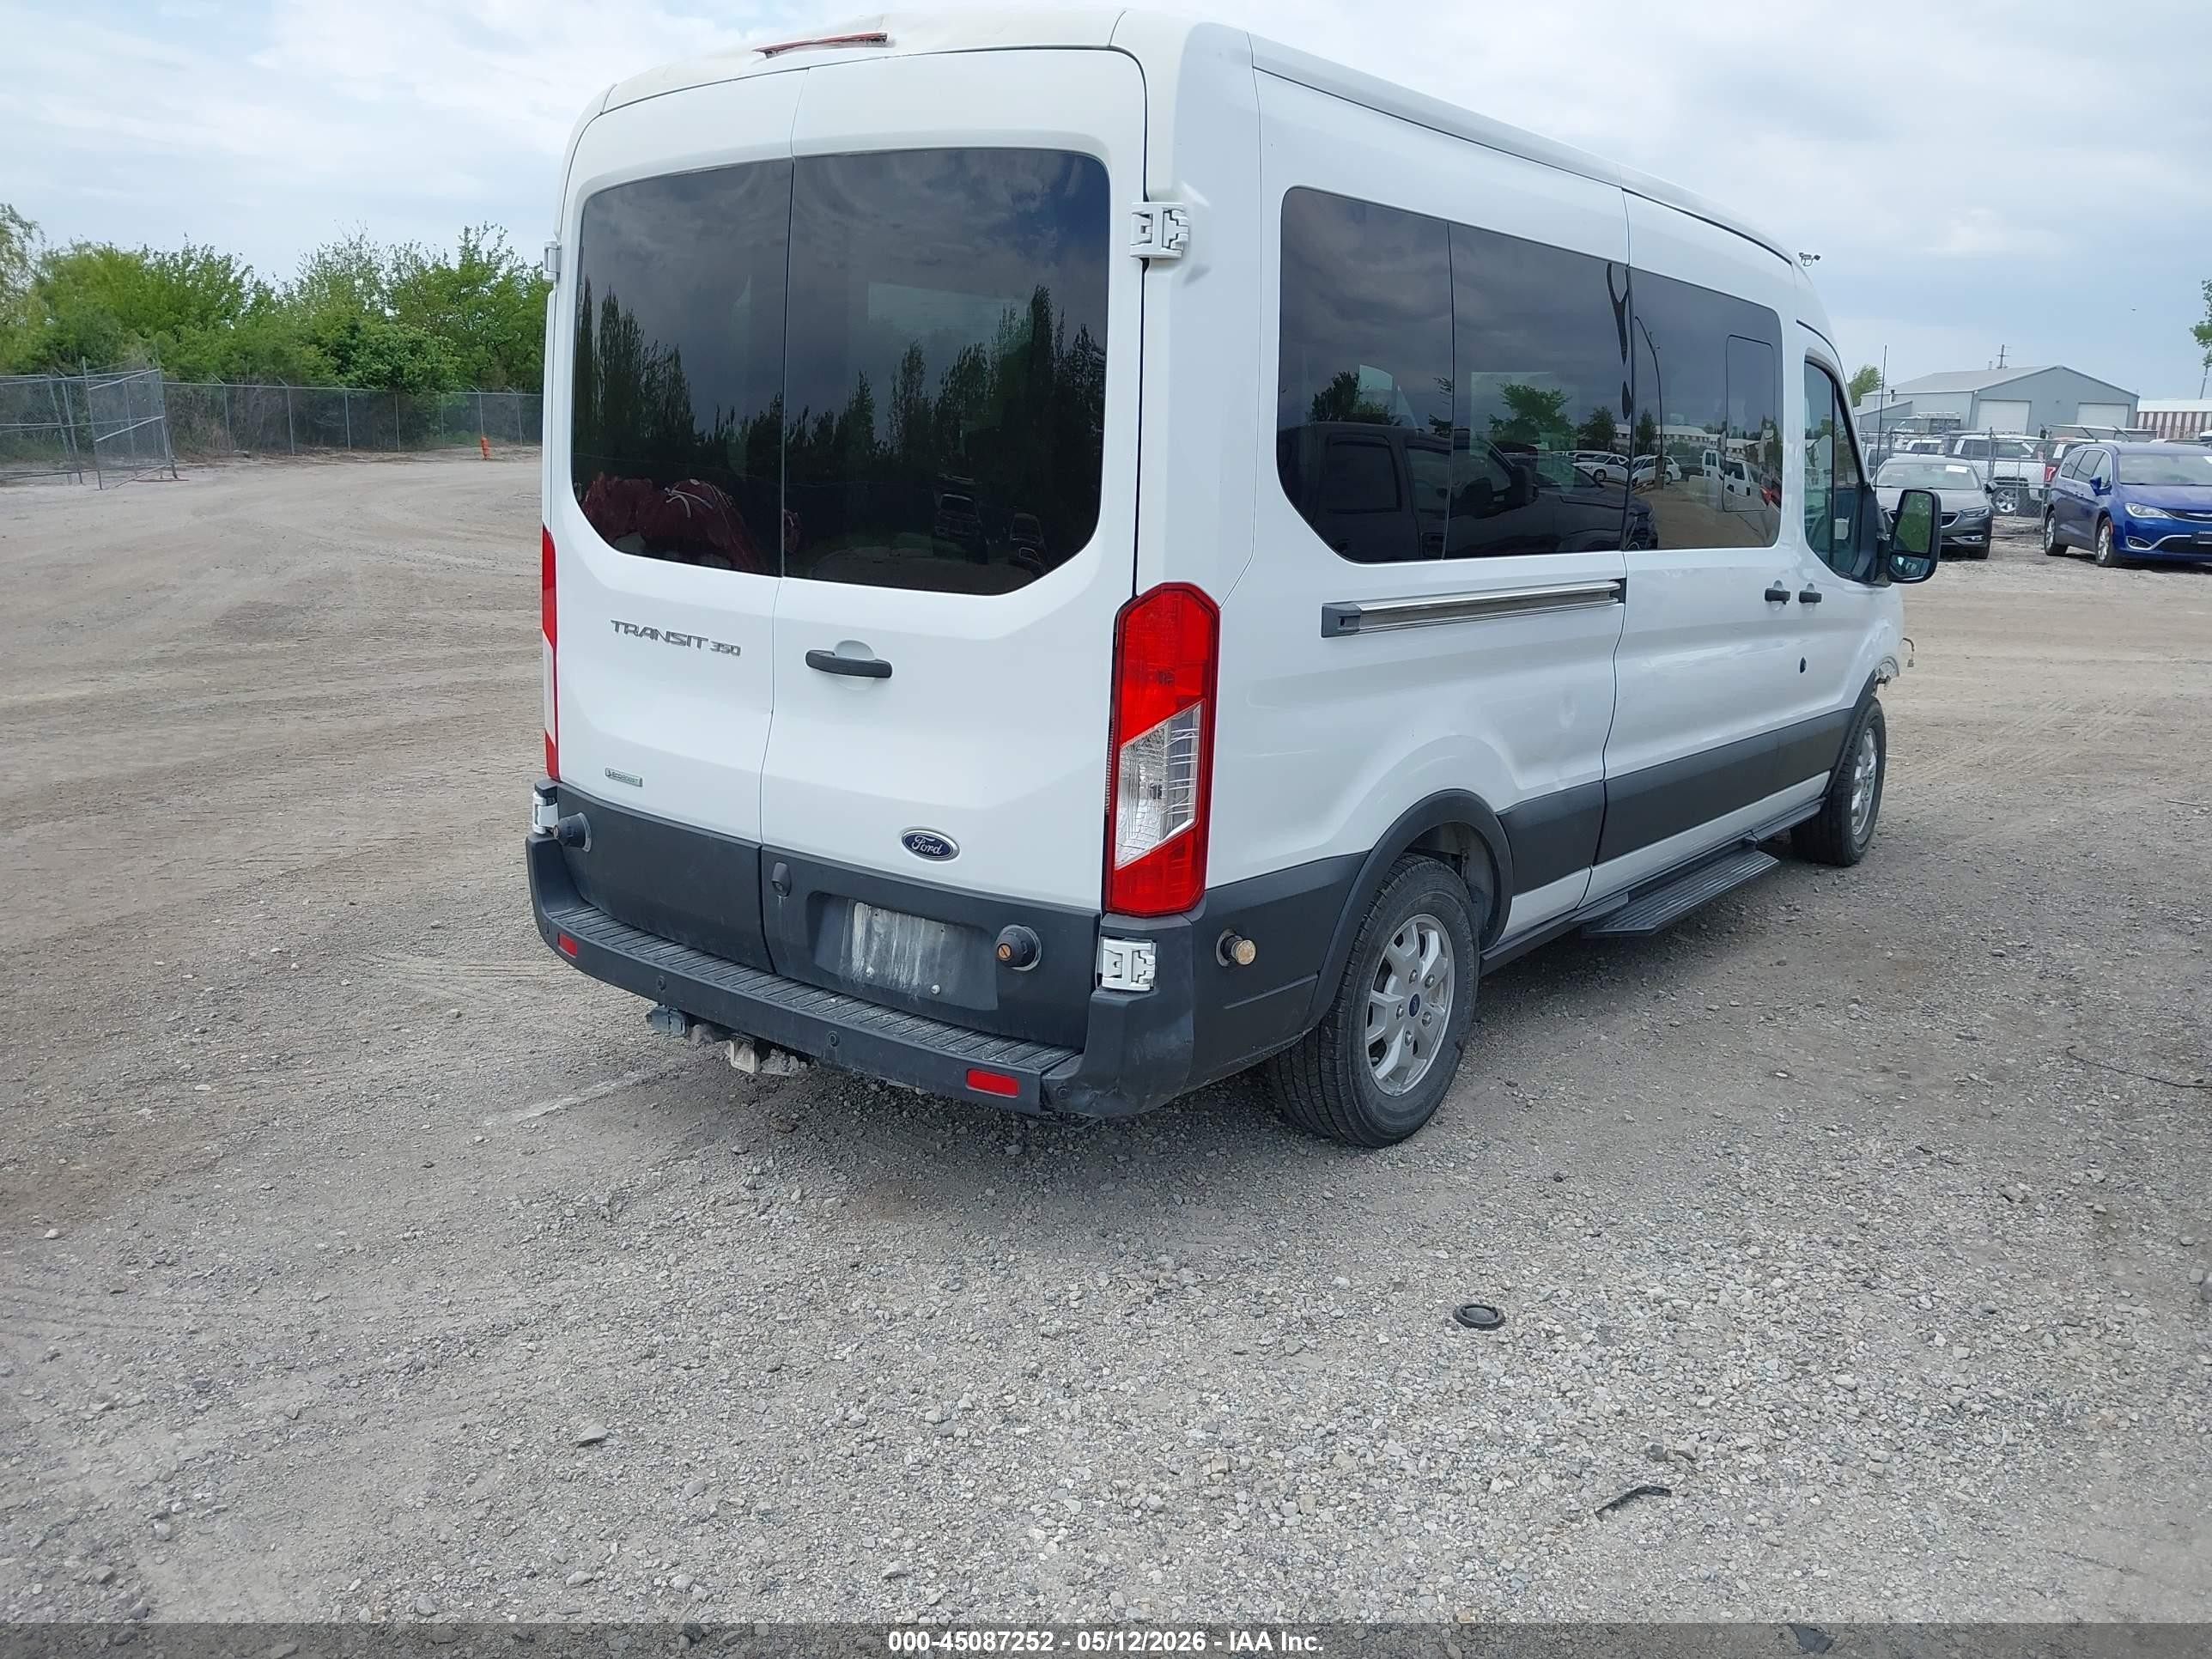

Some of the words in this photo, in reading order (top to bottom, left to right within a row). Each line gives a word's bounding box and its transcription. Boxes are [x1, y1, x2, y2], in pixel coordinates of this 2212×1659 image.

[611, 619, 708, 650] TRANSIT
[710, 641, 741, 656] 350
[911, 835, 944, 855] Ford
